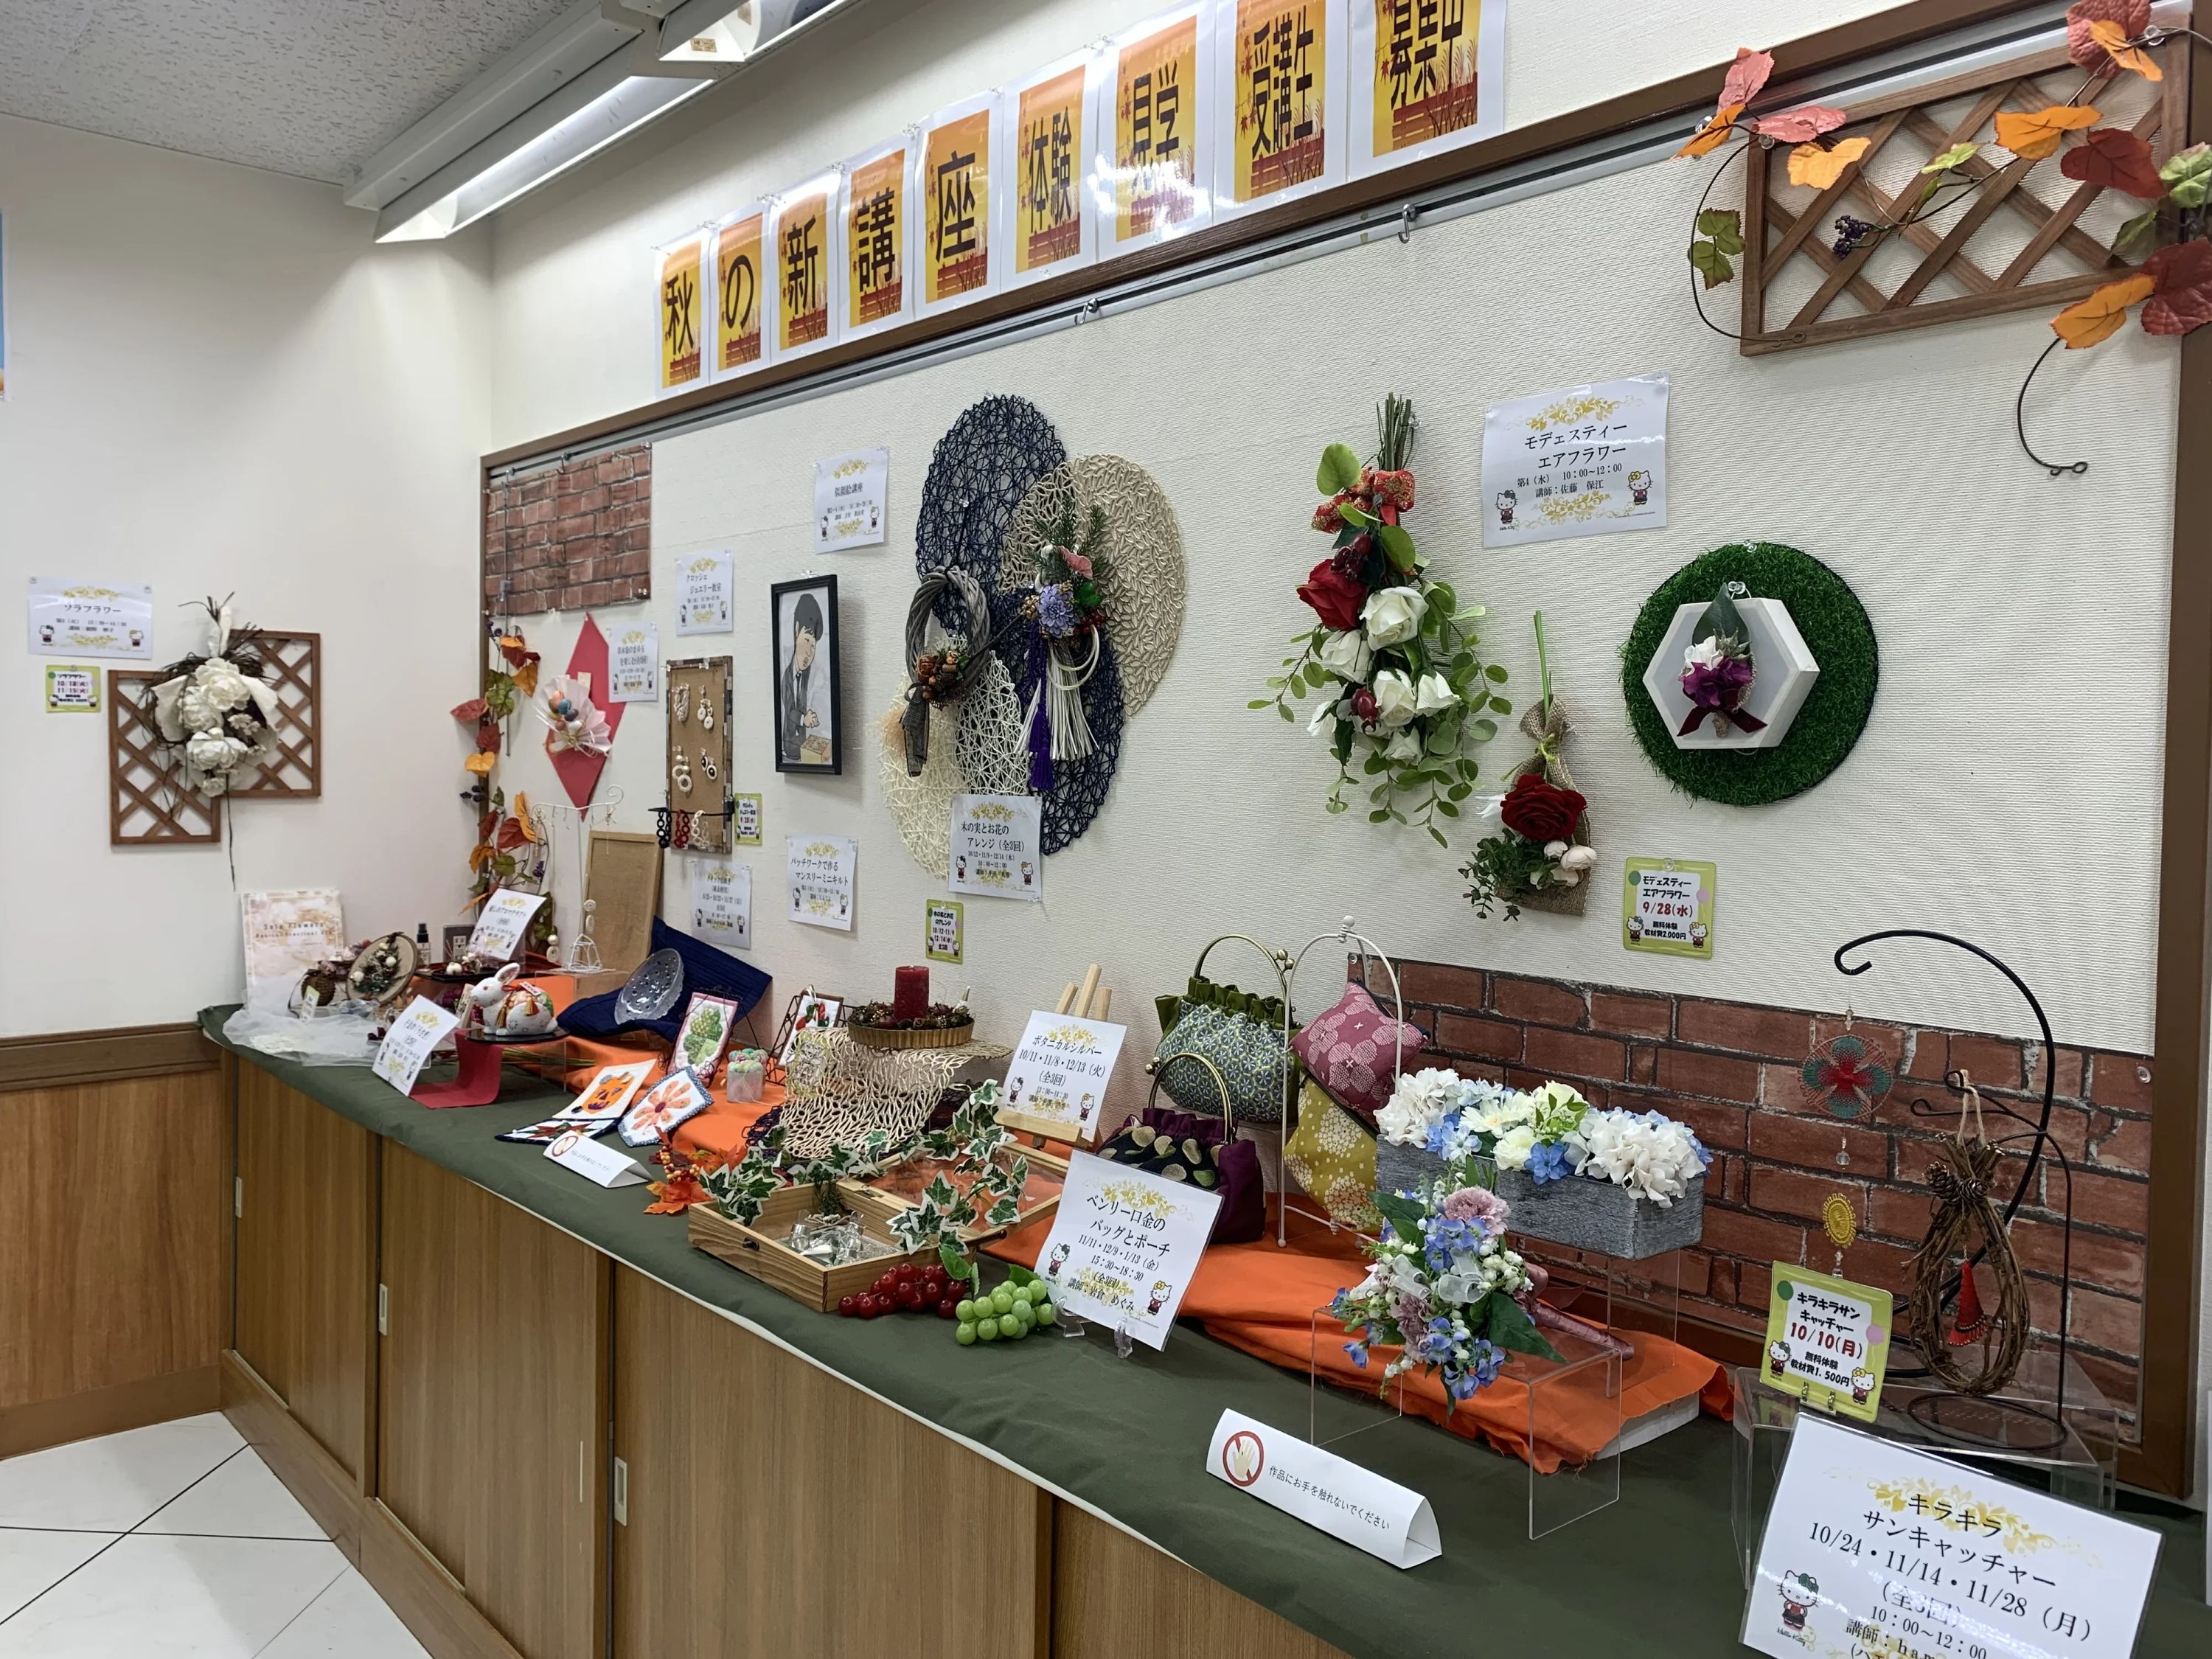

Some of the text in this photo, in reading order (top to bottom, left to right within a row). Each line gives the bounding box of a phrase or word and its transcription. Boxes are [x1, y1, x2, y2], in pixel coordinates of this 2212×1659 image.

[1538, 445, 1627, 470] エアフラワー
[64, 604, 122, 613] ソラフラワー
[961, 821, 1009, 835] 木の実とお花の
[796, 872, 849, 887] マンスリーミニキルト
[1642, 888, 1691, 900] エアフラワー
[1642, 900, 1694, 918] 9/28(水)
[1032, 1034, 1102, 1056] ボタニカルシルバー
[1087, 1194, 1166, 1231] ベンリー口金の
[1090, 1220, 1170, 1257] バッグとポーチ
[1110, 1295, 1135, 1312] めぐみ
[1797, 1292, 1860, 1320] キラキラサン
[1800, 1310, 1854, 1333] キャッチャー
[1790, 1322, 1863, 1360] 10/10(月)
[1804, 1351, 1840, 1371] 無料体験
[1269, 1464, 1390, 1530] 作品にお手を触れないでください
[1907, 1493, 2003, 1539] キラキラ
[1863, 1510, 2057, 1587] サンキャッチャー
